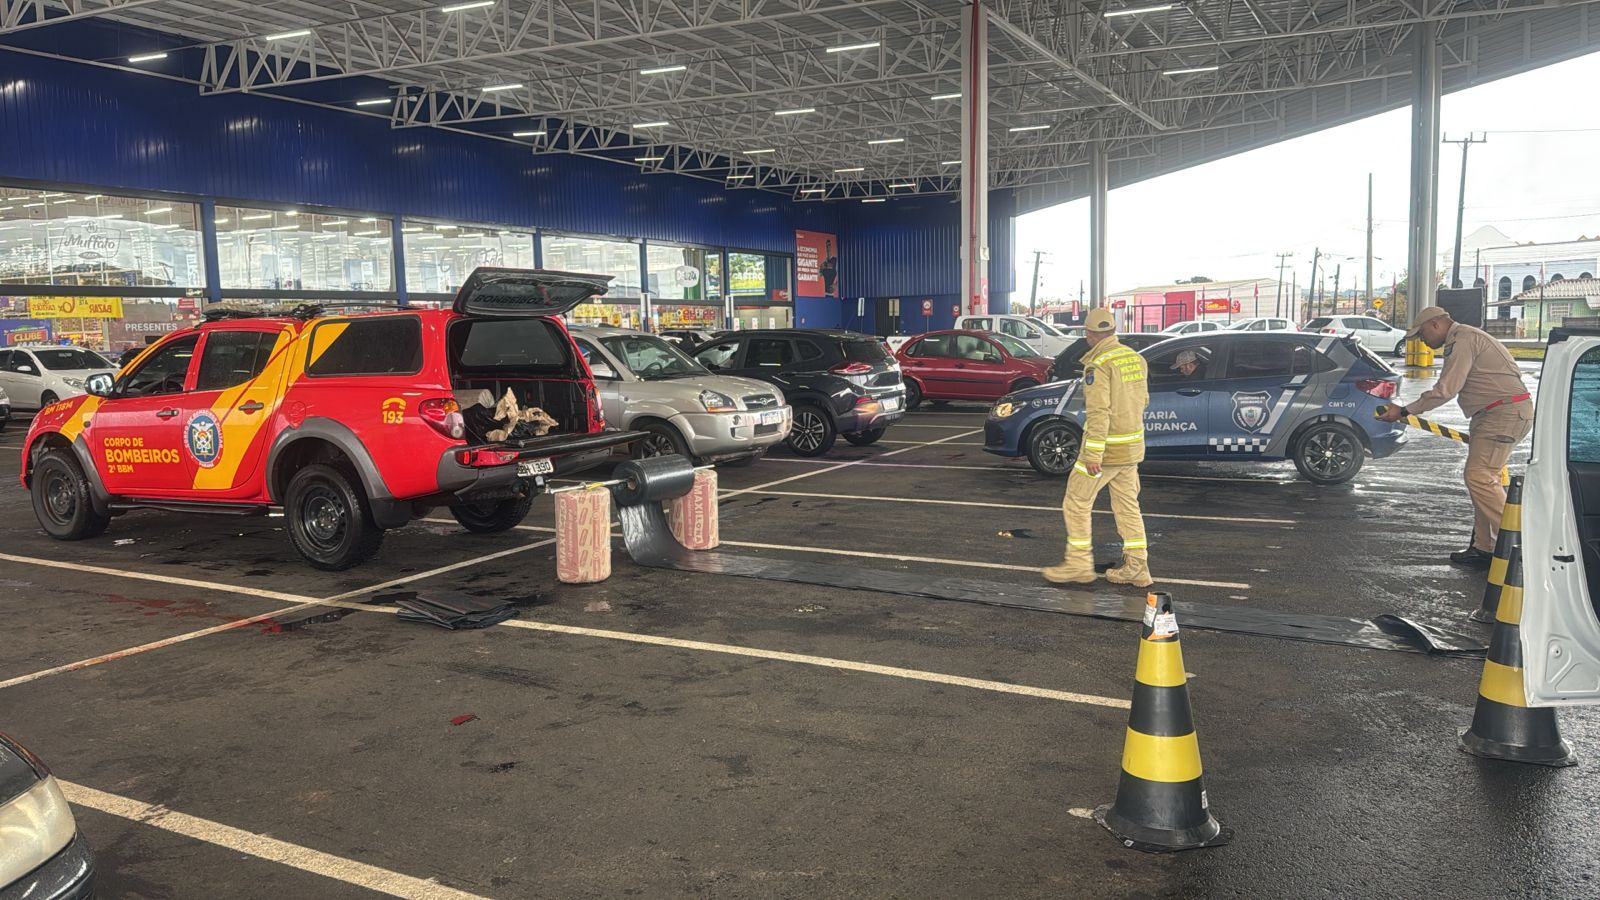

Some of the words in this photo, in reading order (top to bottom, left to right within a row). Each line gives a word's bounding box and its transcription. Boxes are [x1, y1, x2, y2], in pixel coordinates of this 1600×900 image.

[64, 234, 115, 249] Muffato
[797, 258, 818, 268] GIGANTE
[797, 272, 818, 282] GARANTE
[125, 323, 178, 332] PRESENTES
[14, 331, 42, 342] CLUBE
[1043, 398, 1060, 406] 153
[382, 410, 404, 425] 193
[1145, 422, 1198, 433] URANÇA
[104, 437, 131, 447] CORPO
[132, 437, 144, 447] DE
[105, 448, 180, 463] BOMBEIROS
[117, 464, 134, 473] BBM
